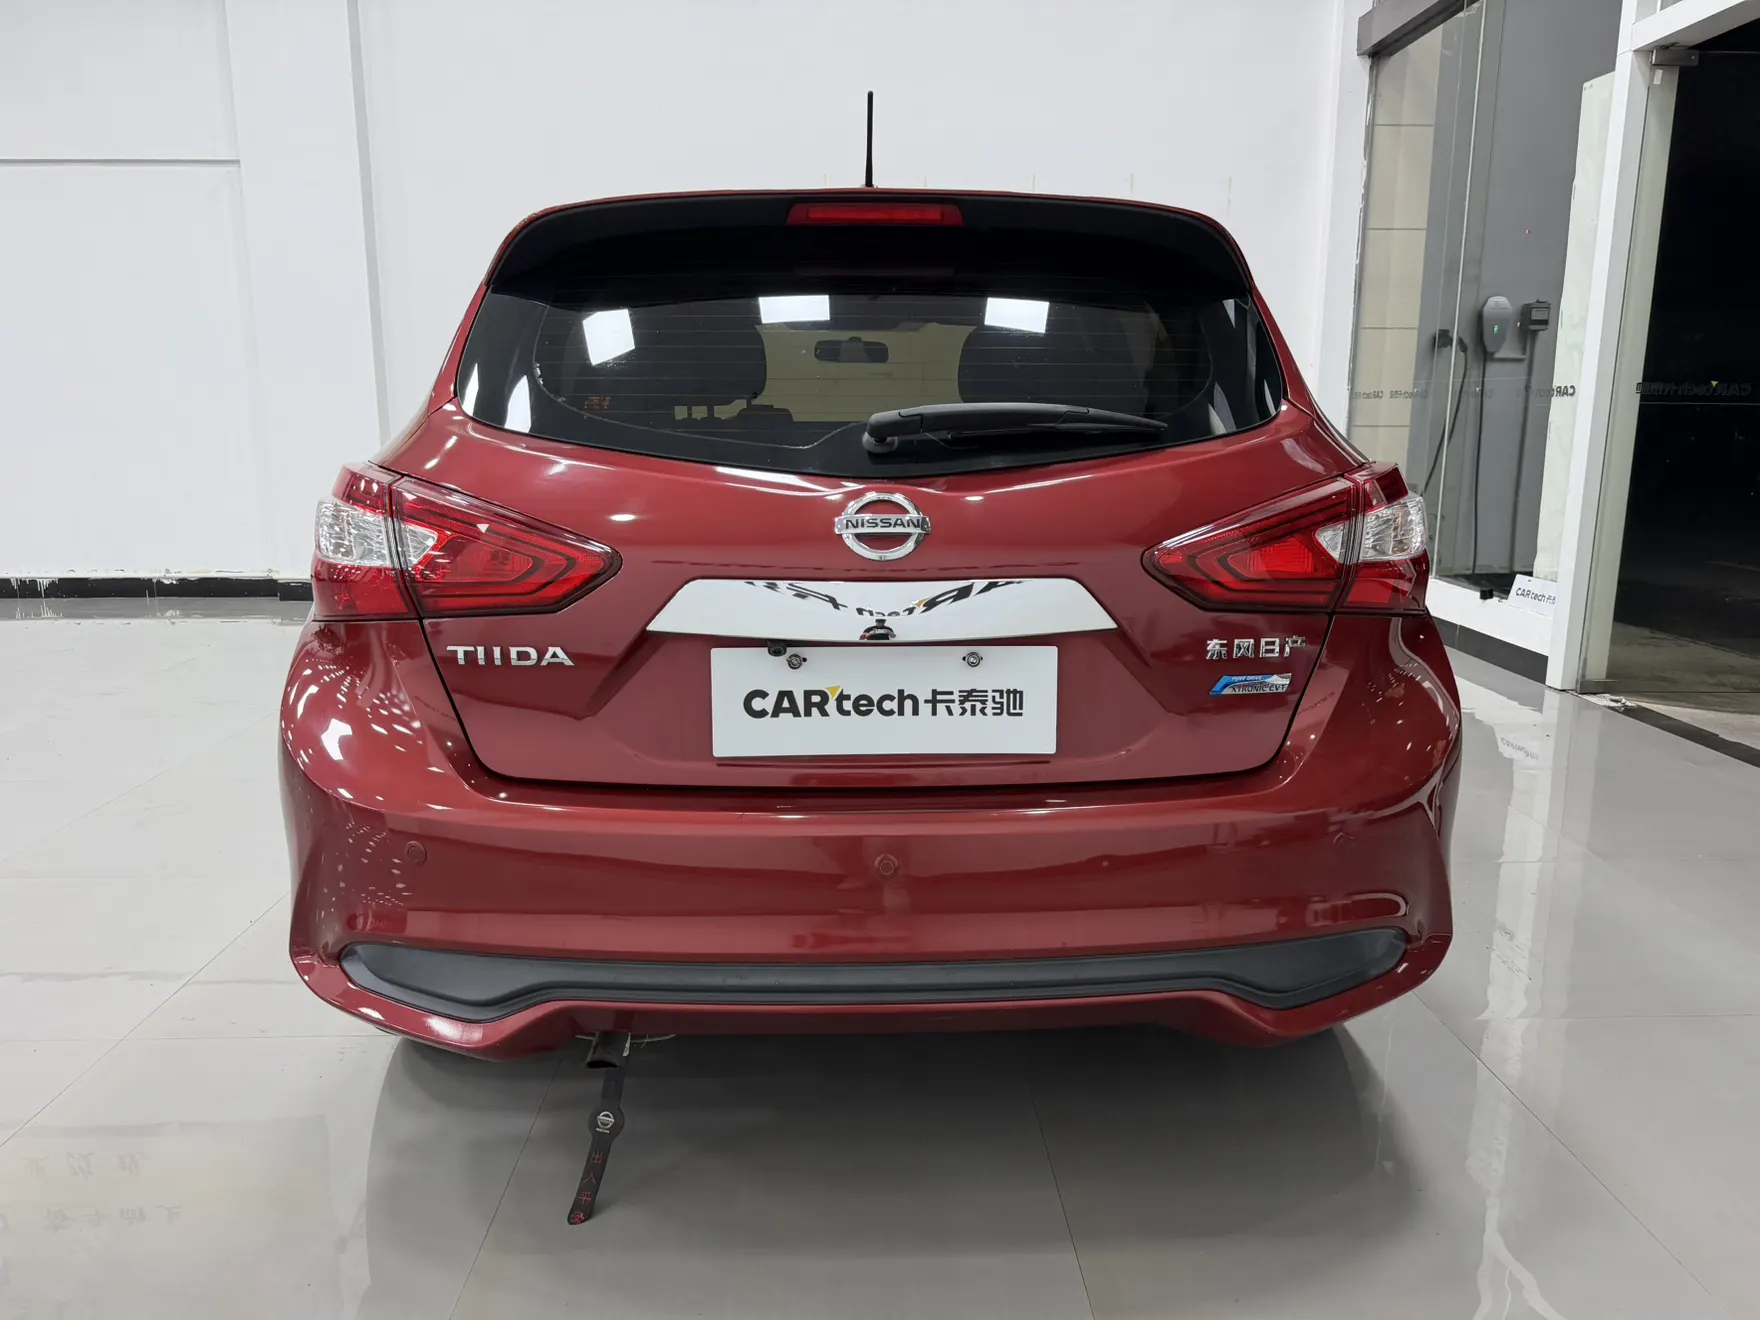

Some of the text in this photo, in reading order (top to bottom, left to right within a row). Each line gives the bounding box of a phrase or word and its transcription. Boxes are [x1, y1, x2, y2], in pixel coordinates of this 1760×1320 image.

[845, 517, 921, 530] NISSAN
[446, 645, 575, 666] TIIDA
[1205, 635, 1306, 660] 东风日产
